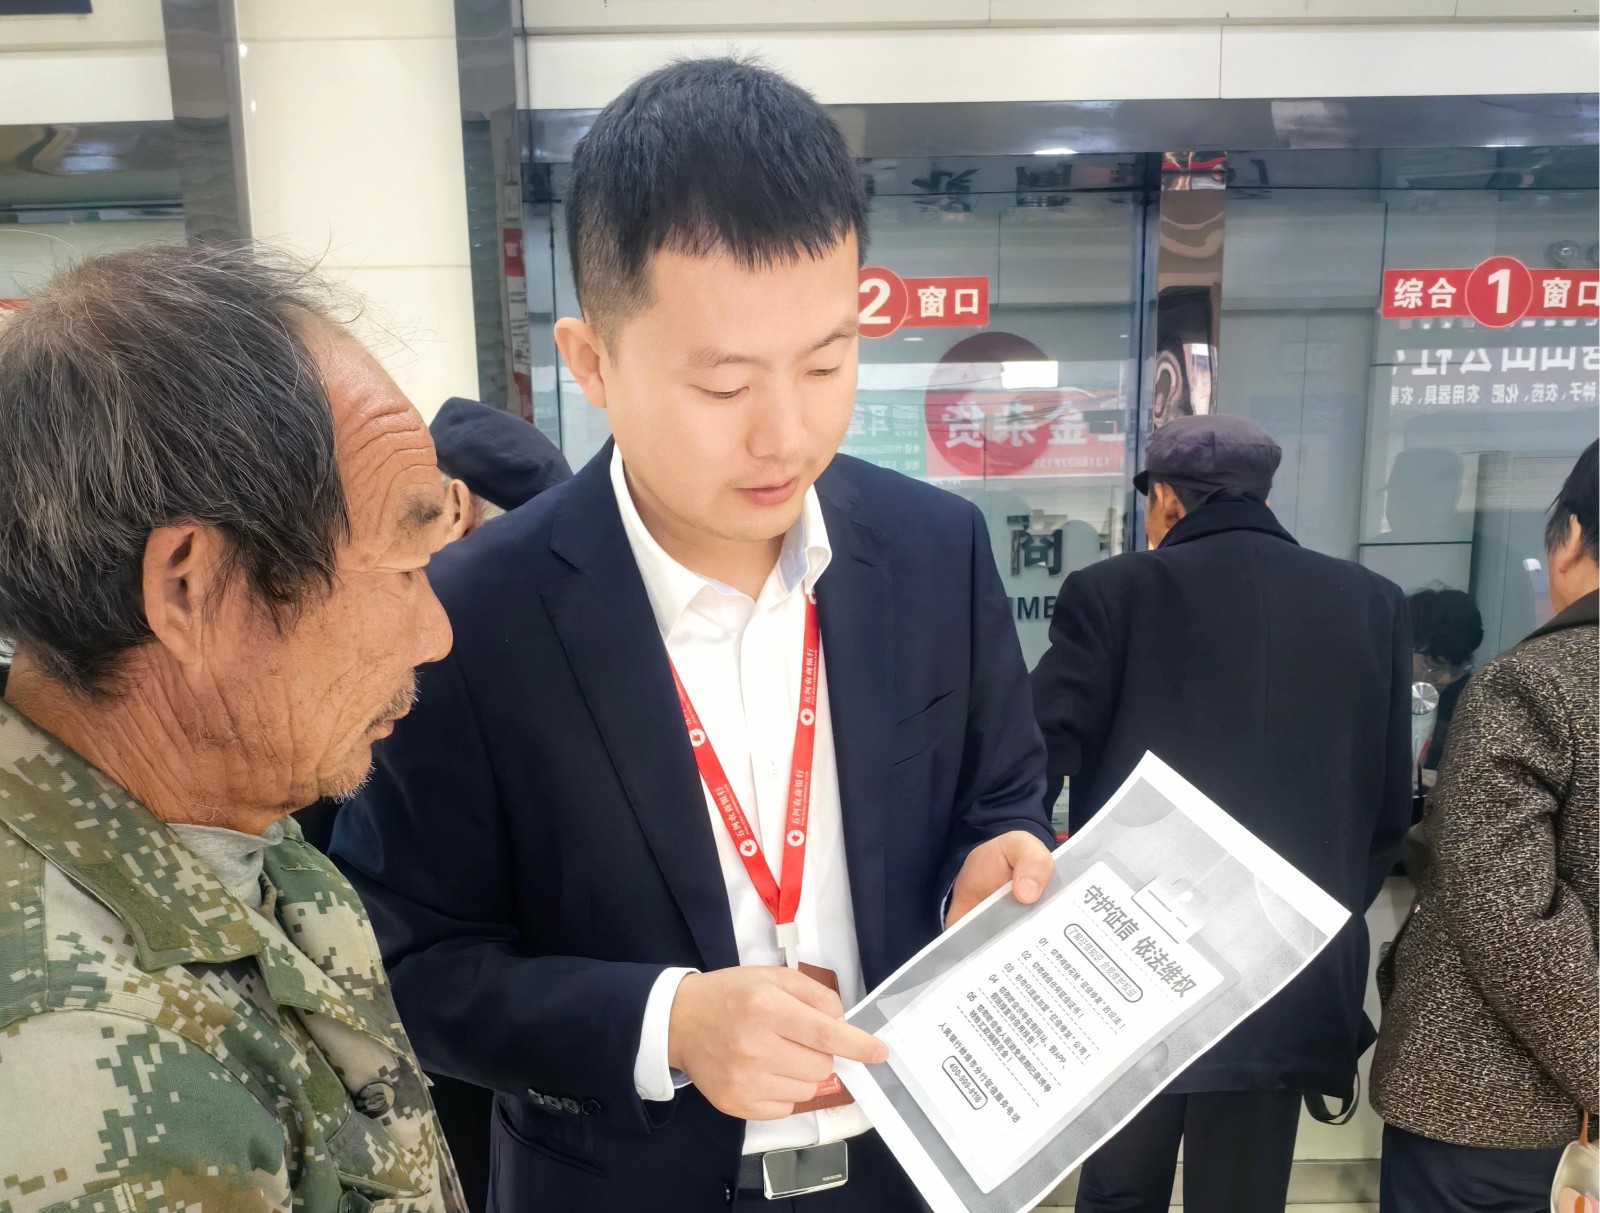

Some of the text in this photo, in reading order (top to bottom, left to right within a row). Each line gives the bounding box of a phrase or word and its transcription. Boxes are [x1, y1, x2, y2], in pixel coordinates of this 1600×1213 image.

[859, 278, 978, 324] 2 窗口
[1394, 269, 1600, 314] 综合 1 窗口
[1007, 510, 1067, 577] 商
[1008, 596, 1056, 620] ME
[1038, 937, 1048, 946] 01
[1083, 884, 1196, 997] 守护征信 依法维权
[1003, 962, 1014, 972] 03
[1021, 950, 1031, 960] 02
[1068, 926, 1136, 997] 了解征信知识 合规维护权益
[988, 974, 999, 983] 04
[966, 991, 977, 1001] 05
